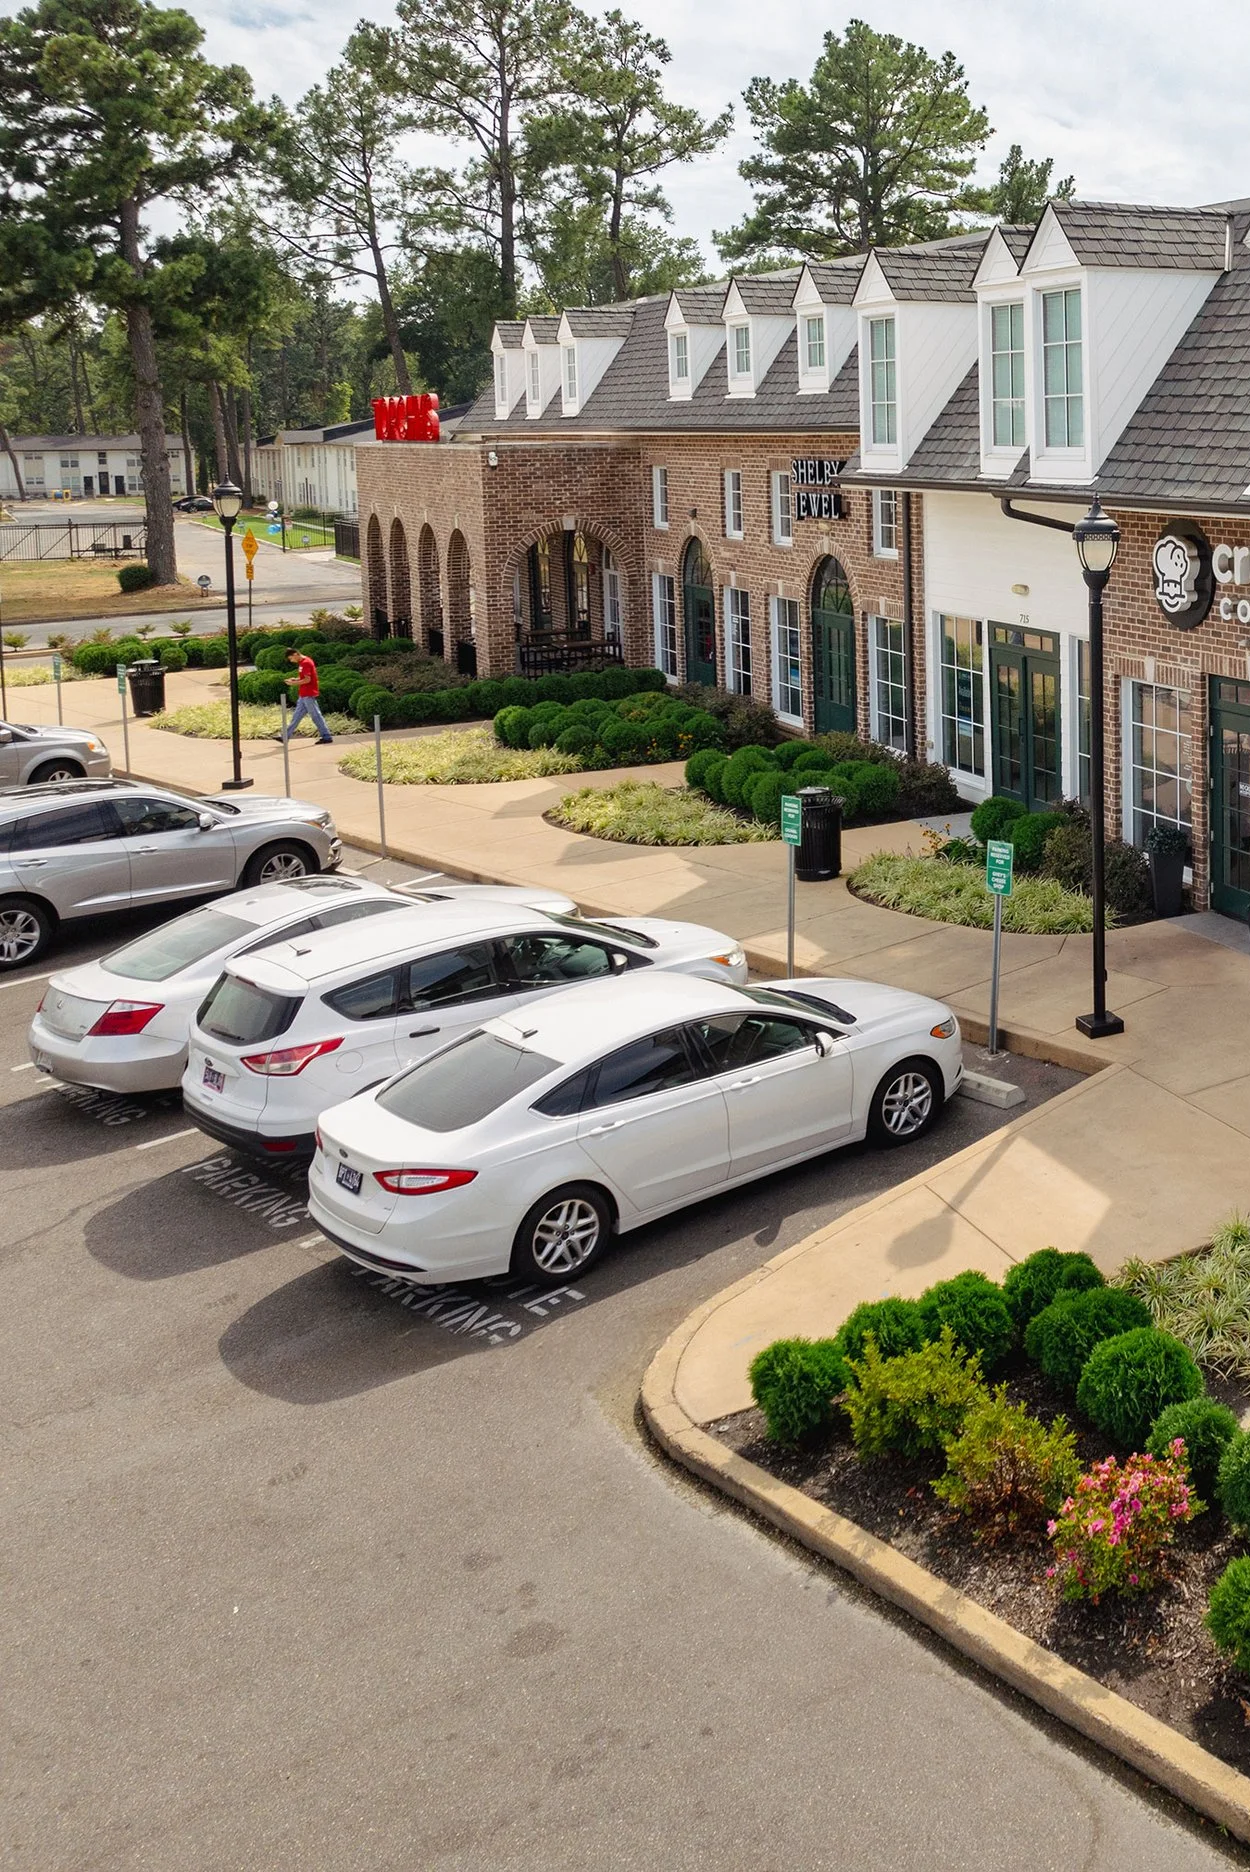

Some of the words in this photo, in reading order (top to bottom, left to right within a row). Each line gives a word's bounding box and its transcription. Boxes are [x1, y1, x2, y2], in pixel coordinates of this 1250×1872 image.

[791, 459, 840, 486] SHELBY
[795, 492, 840, 520] JEWEL
[1020, 613, 1030, 624] 715
[181, 1156, 310, 1228] PARKING
